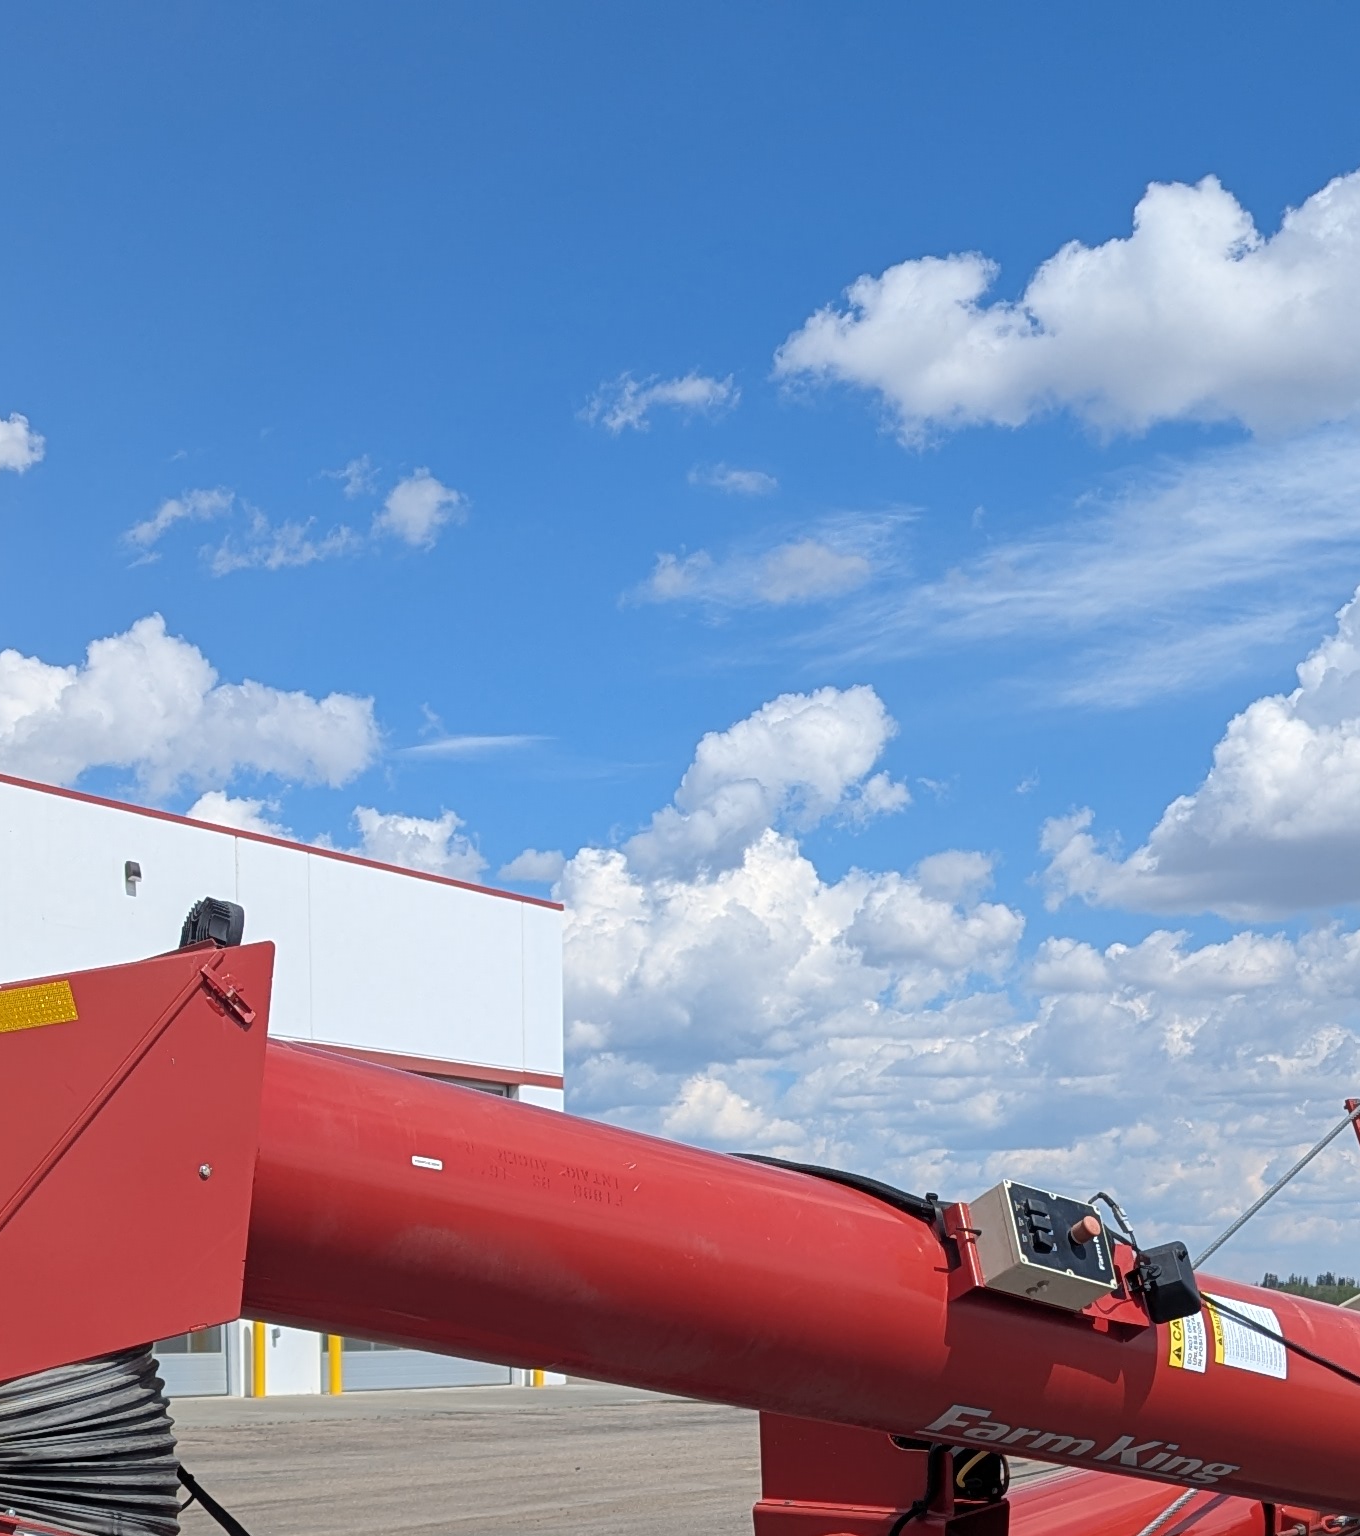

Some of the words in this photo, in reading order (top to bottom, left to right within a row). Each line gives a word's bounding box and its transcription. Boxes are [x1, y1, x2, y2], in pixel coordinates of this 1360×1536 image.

[1172, 1320, 1182, 1342] CA
[924, 1404, 1096, 1457] Farm
[1092, 1435, 1241, 1485] King
